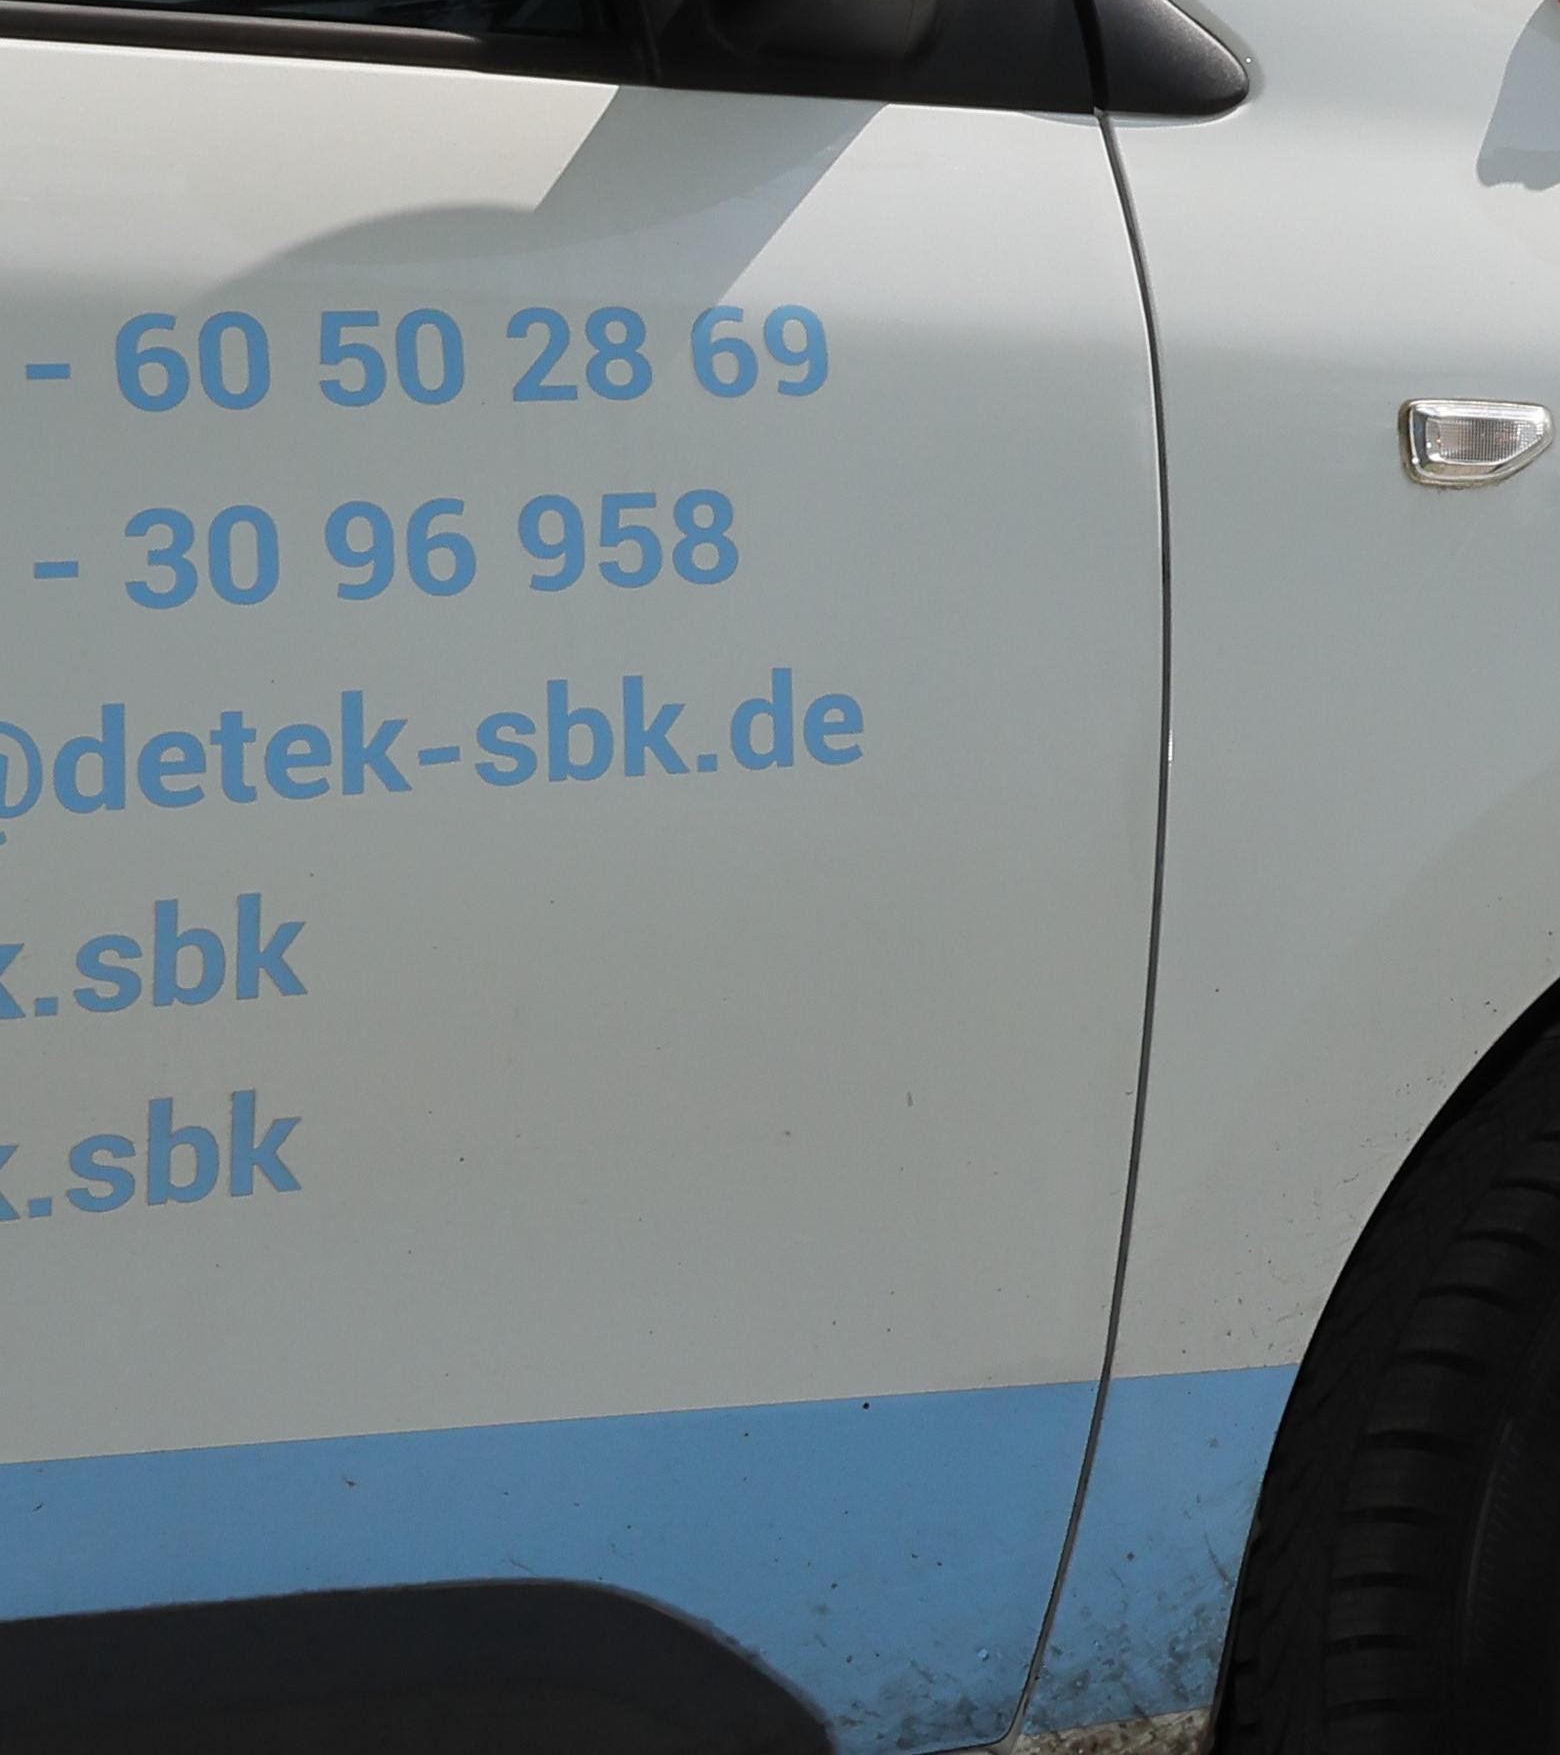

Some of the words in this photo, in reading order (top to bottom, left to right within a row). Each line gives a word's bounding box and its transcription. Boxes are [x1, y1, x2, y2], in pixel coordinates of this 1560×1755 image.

[114, 311, 271, 413] 60
[317, 309, 466, 408] 50
[505, 306, 654, 403] 28
[690, 304, 830, 398] 69
[124, 505, 281, 610] 30
[323, 498, 478, 602] 96
[517, 489, 740, 593] 958
